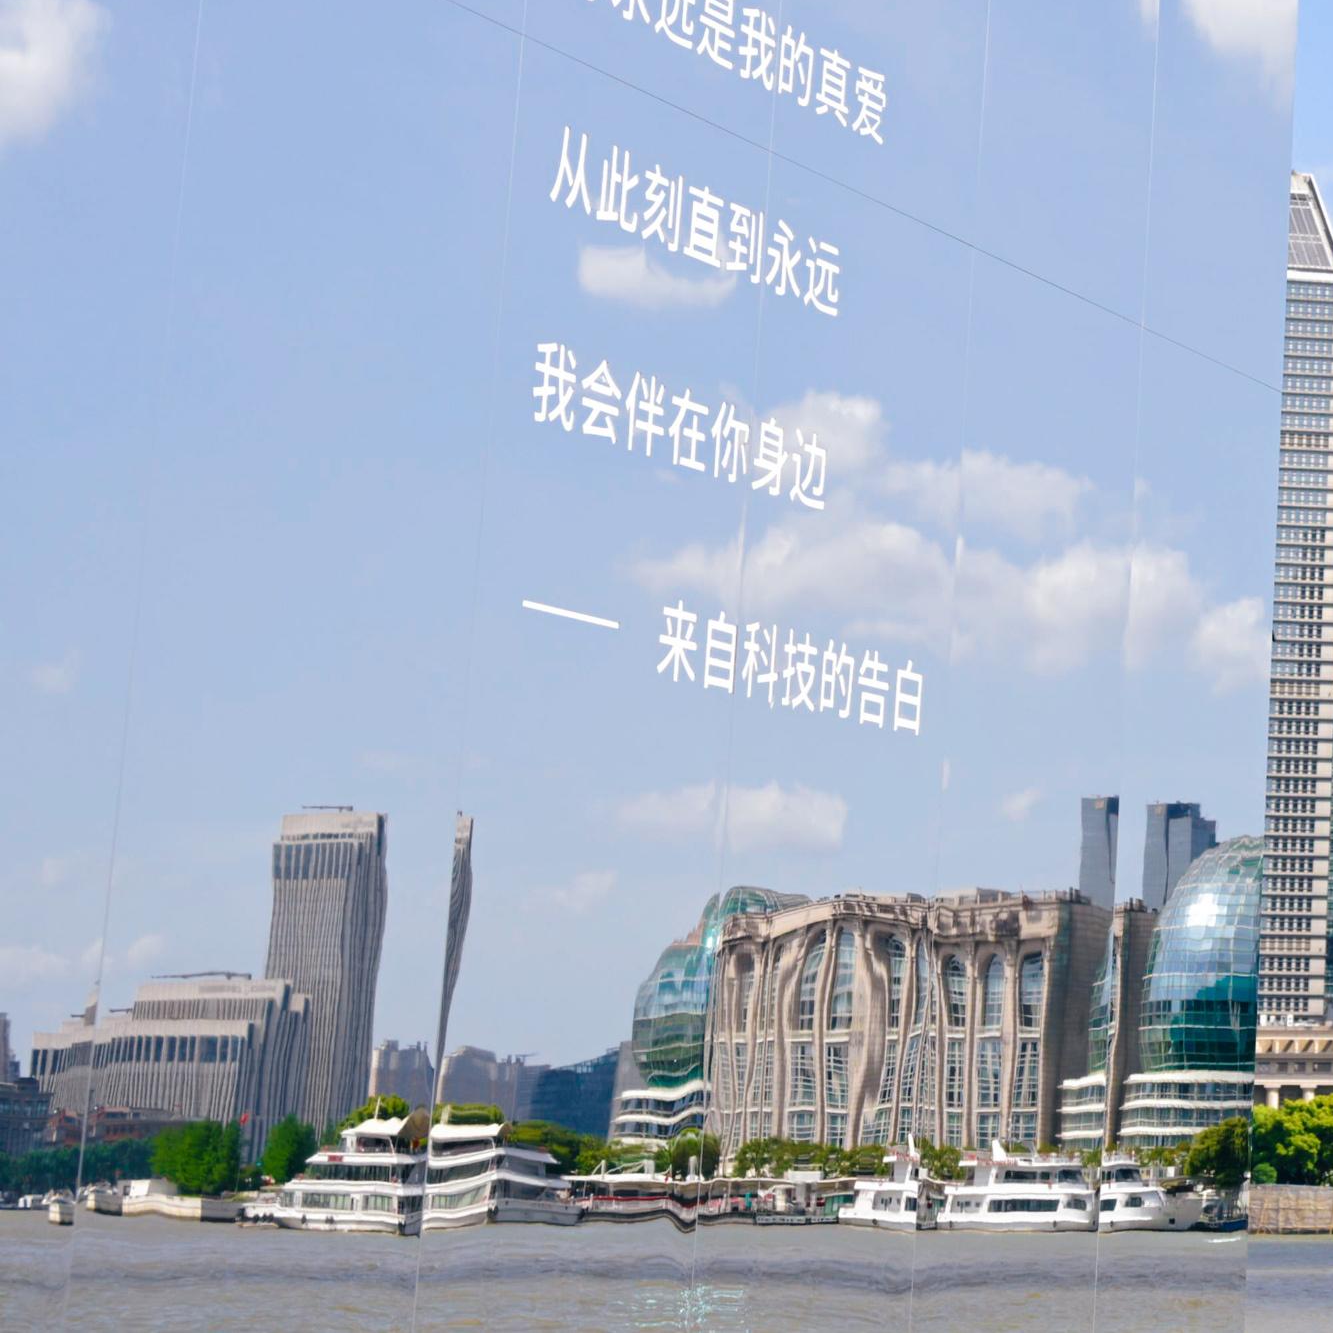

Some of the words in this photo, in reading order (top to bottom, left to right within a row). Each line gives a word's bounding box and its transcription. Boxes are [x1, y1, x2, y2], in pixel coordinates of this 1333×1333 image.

[549, 126, 840, 317] 从此刻直到永远
[532, 342, 828, 511] 我会伴在你身边
[656, 600, 925, 737] 来自科技的告白
